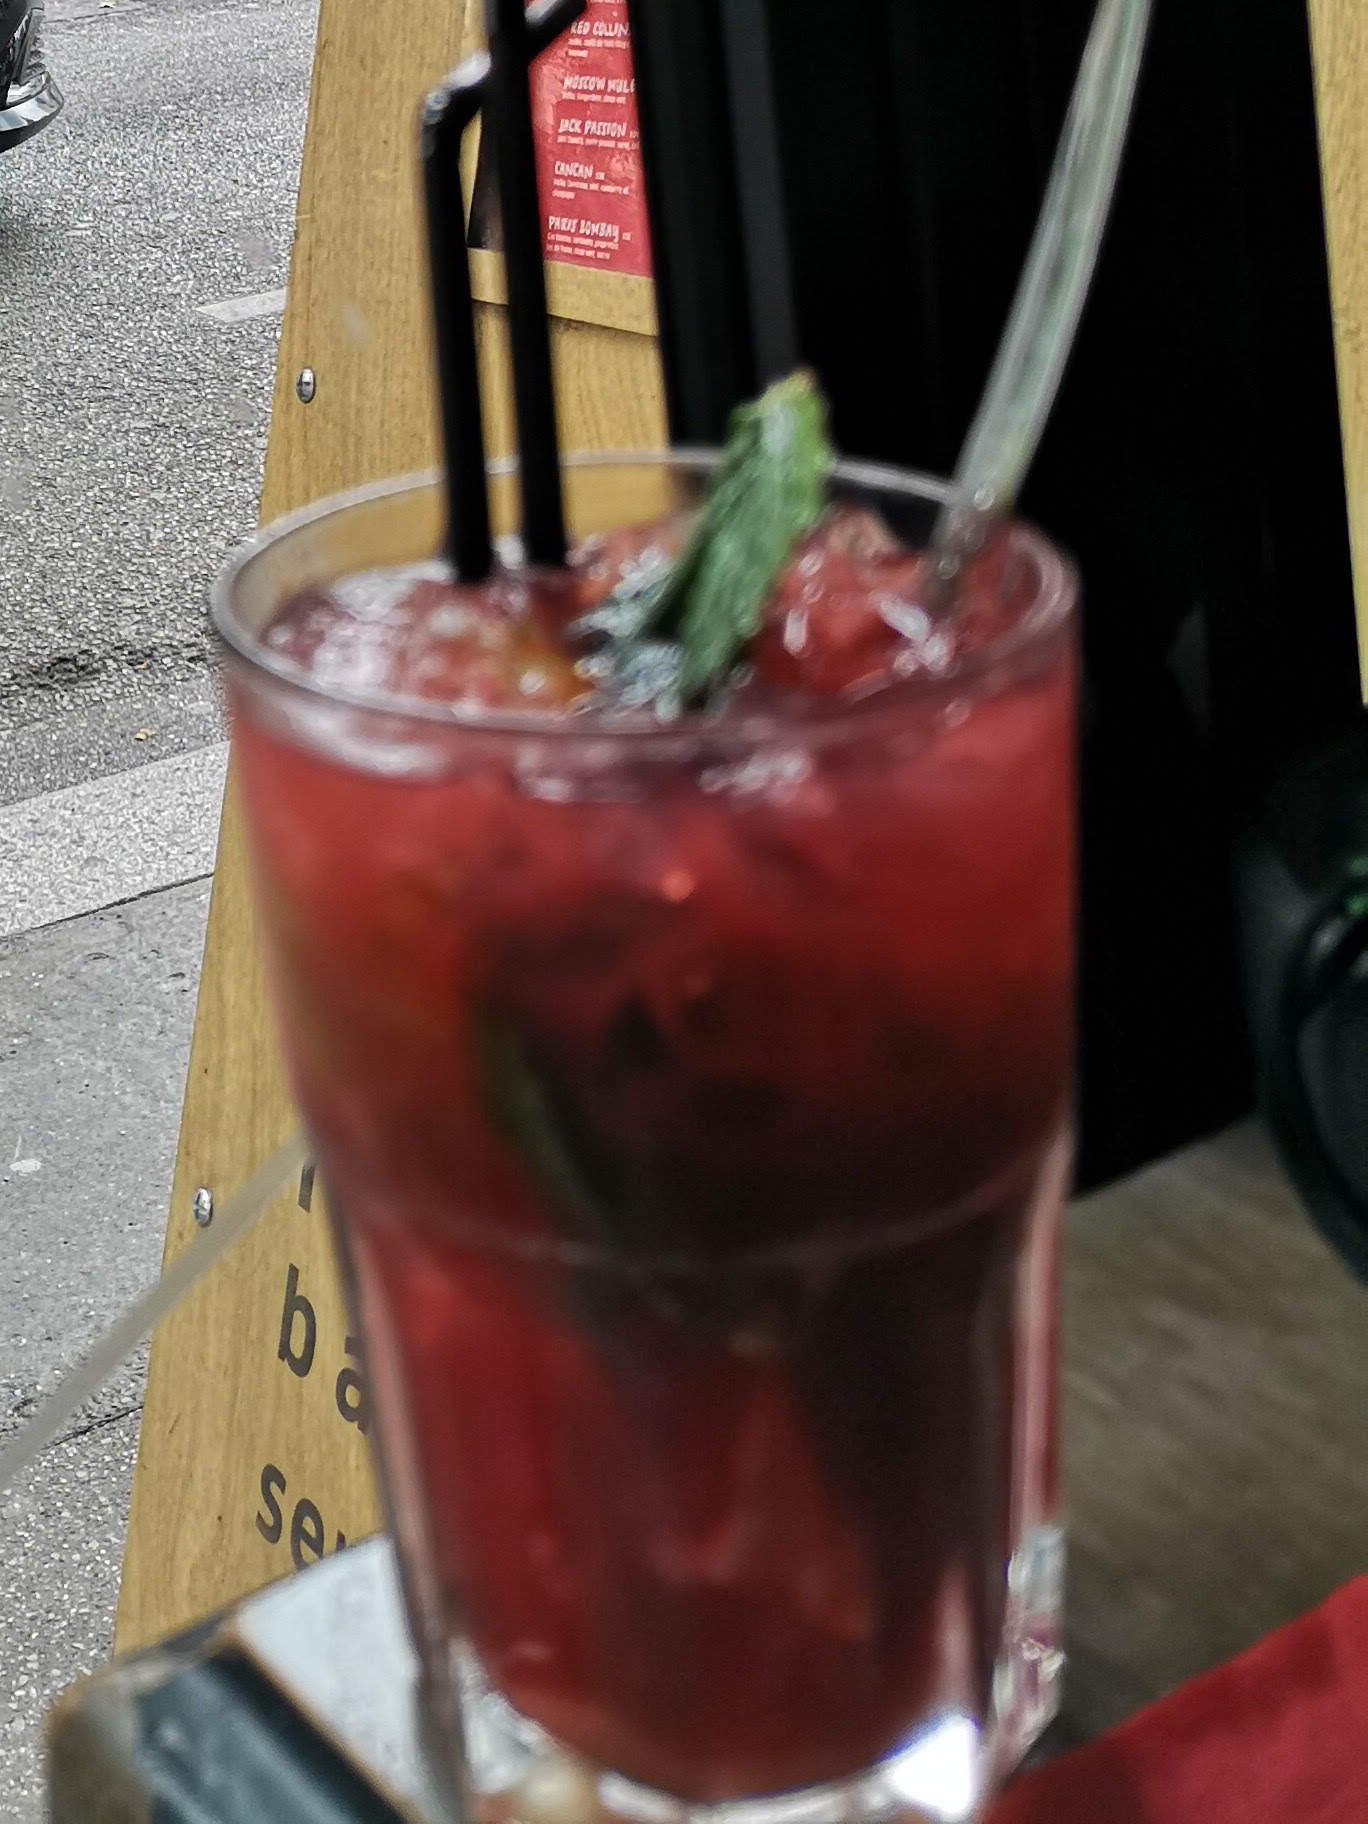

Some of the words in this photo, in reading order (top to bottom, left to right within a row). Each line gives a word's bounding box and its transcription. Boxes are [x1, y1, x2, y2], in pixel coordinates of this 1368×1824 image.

[592, 21, 631, 38] COLLIN
[562, 74, 607, 91] MOSCOW
[558, 118, 583, 134] JACK
[583, 119, 628, 138] PASSION
[554, 160, 594, 179] CANCAN
[548, 215, 579, 233] PARIS
[579, 219, 620, 243] BOMBAY
